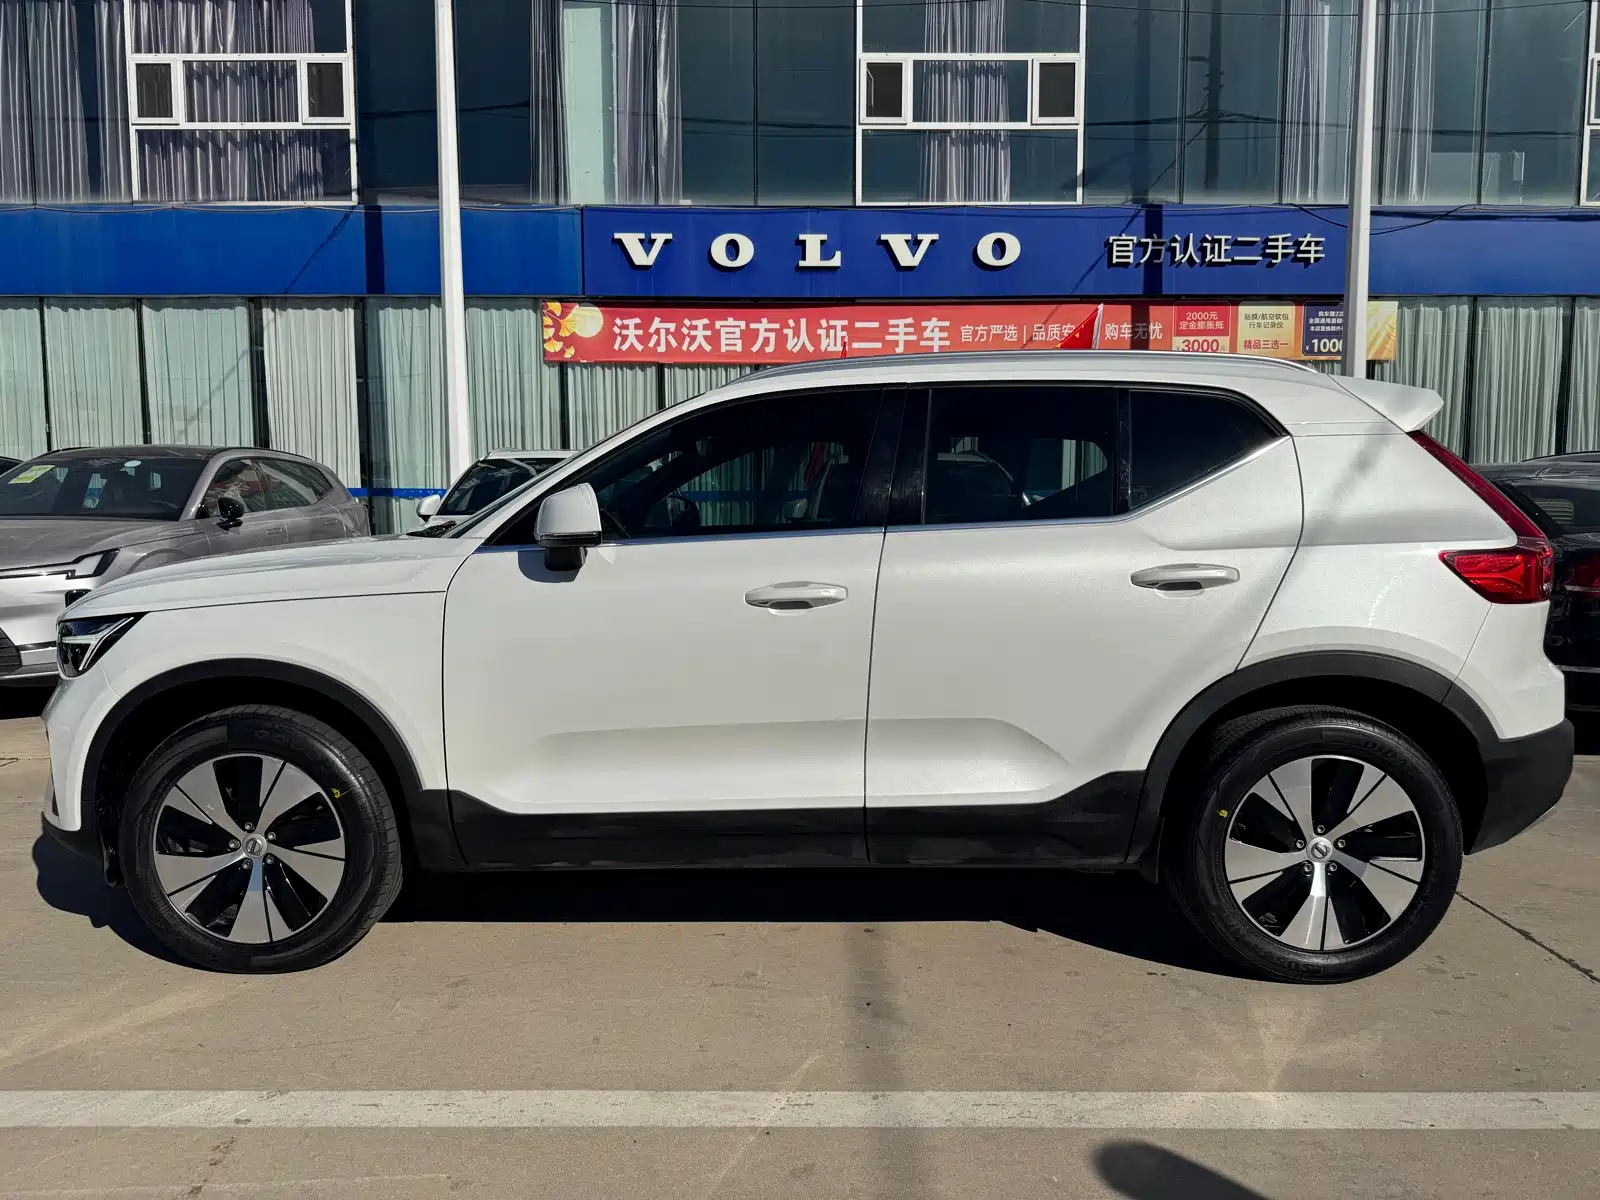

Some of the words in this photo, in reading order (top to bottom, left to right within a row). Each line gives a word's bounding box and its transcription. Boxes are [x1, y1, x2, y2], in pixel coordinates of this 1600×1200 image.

[614, 232, 1021, 267] VOLVO
[1108, 233, 1326, 264] 官方认证二手车
[1186, 311, 1219, 321] 2000元
[1248, 321, 1284, 329] 行车记录仪
[613, 316, 951, 353] 沃尔沃官方认证二手车
[960, 324, 1018, 342] 官方严选
[1032, 323, 1076, 341] 品质安
[1104, 323, 1163, 341] 购车无忧
[1243, 339, 1289, 350] 精品三选一
